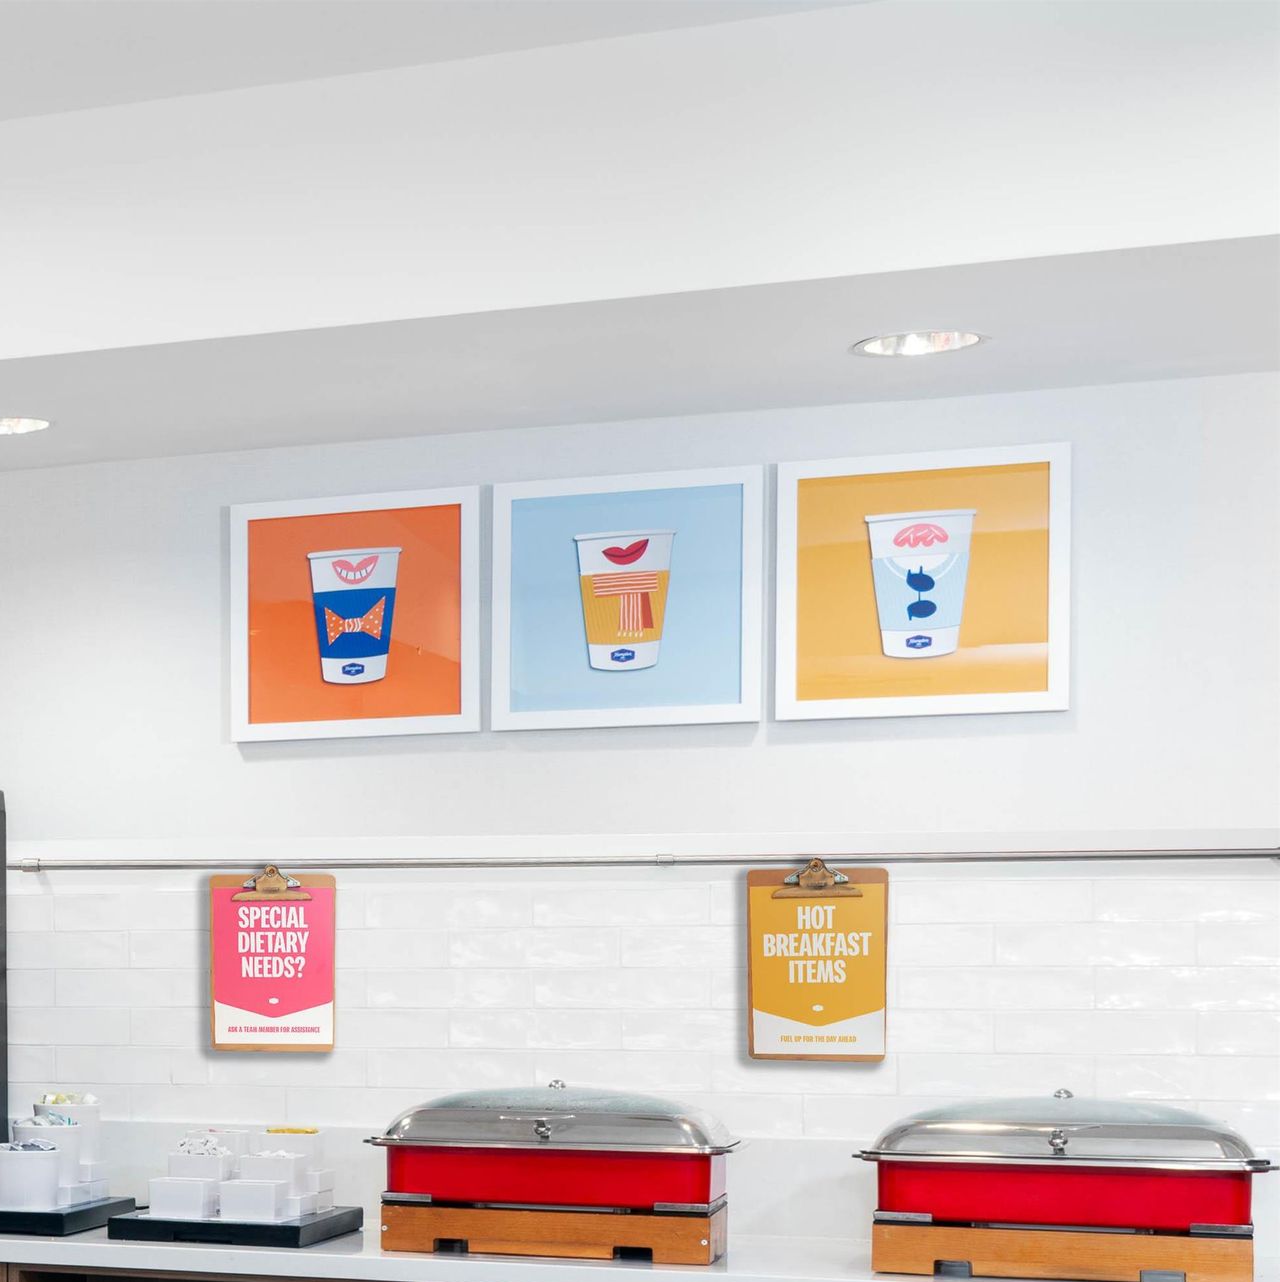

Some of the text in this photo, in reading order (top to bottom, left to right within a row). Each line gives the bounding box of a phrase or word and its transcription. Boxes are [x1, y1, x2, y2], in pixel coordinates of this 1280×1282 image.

[238, 906, 308, 928] SPECIAL
[797, 905, 836, 929] HOT
[237, 931, 309, 953] DIETARY
[763, 932, 872, 957] BREAKFAST
[241, 956, 305, 978] NEEDS?
[788, 960, 846, 983] ITEMS
